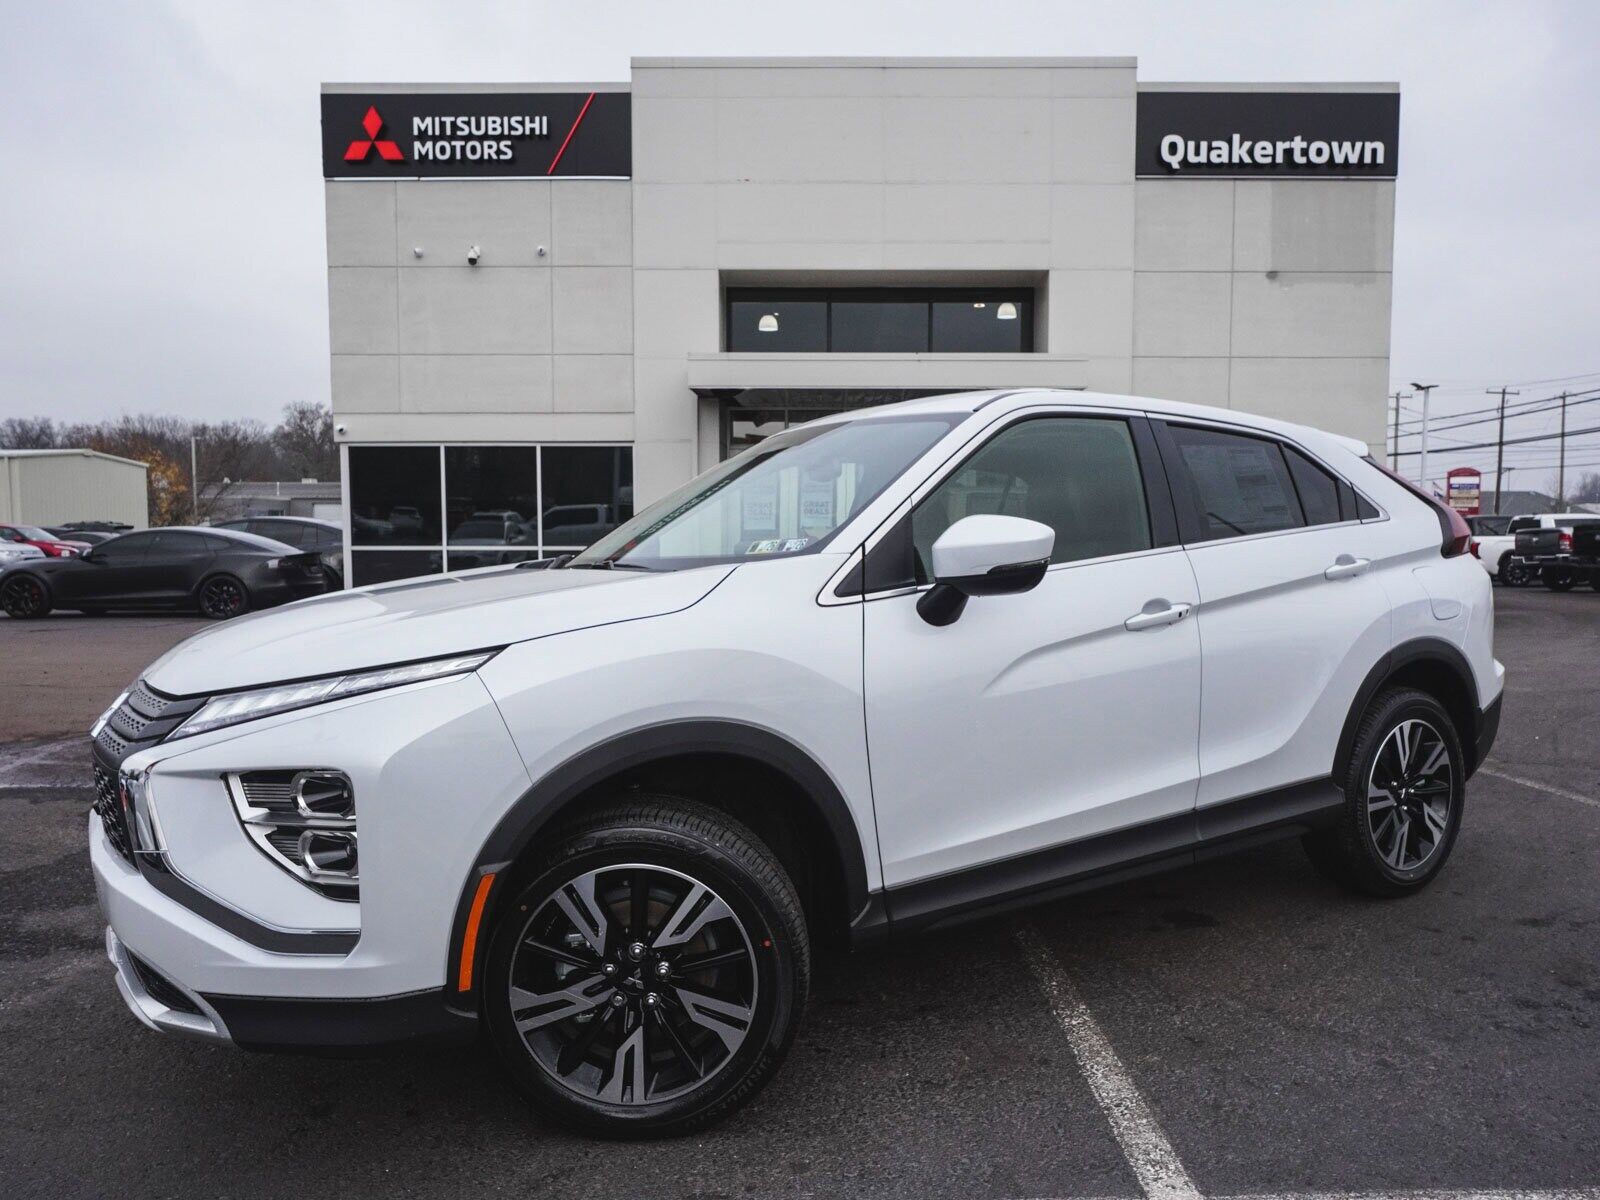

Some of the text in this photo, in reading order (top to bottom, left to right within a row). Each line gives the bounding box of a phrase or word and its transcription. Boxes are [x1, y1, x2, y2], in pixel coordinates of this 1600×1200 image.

[412, 115, 548, 137] MITSUBISHI
[413, 140, 513, 161] MOTORS
[1160, 133, 1385, 170] Quakertown
